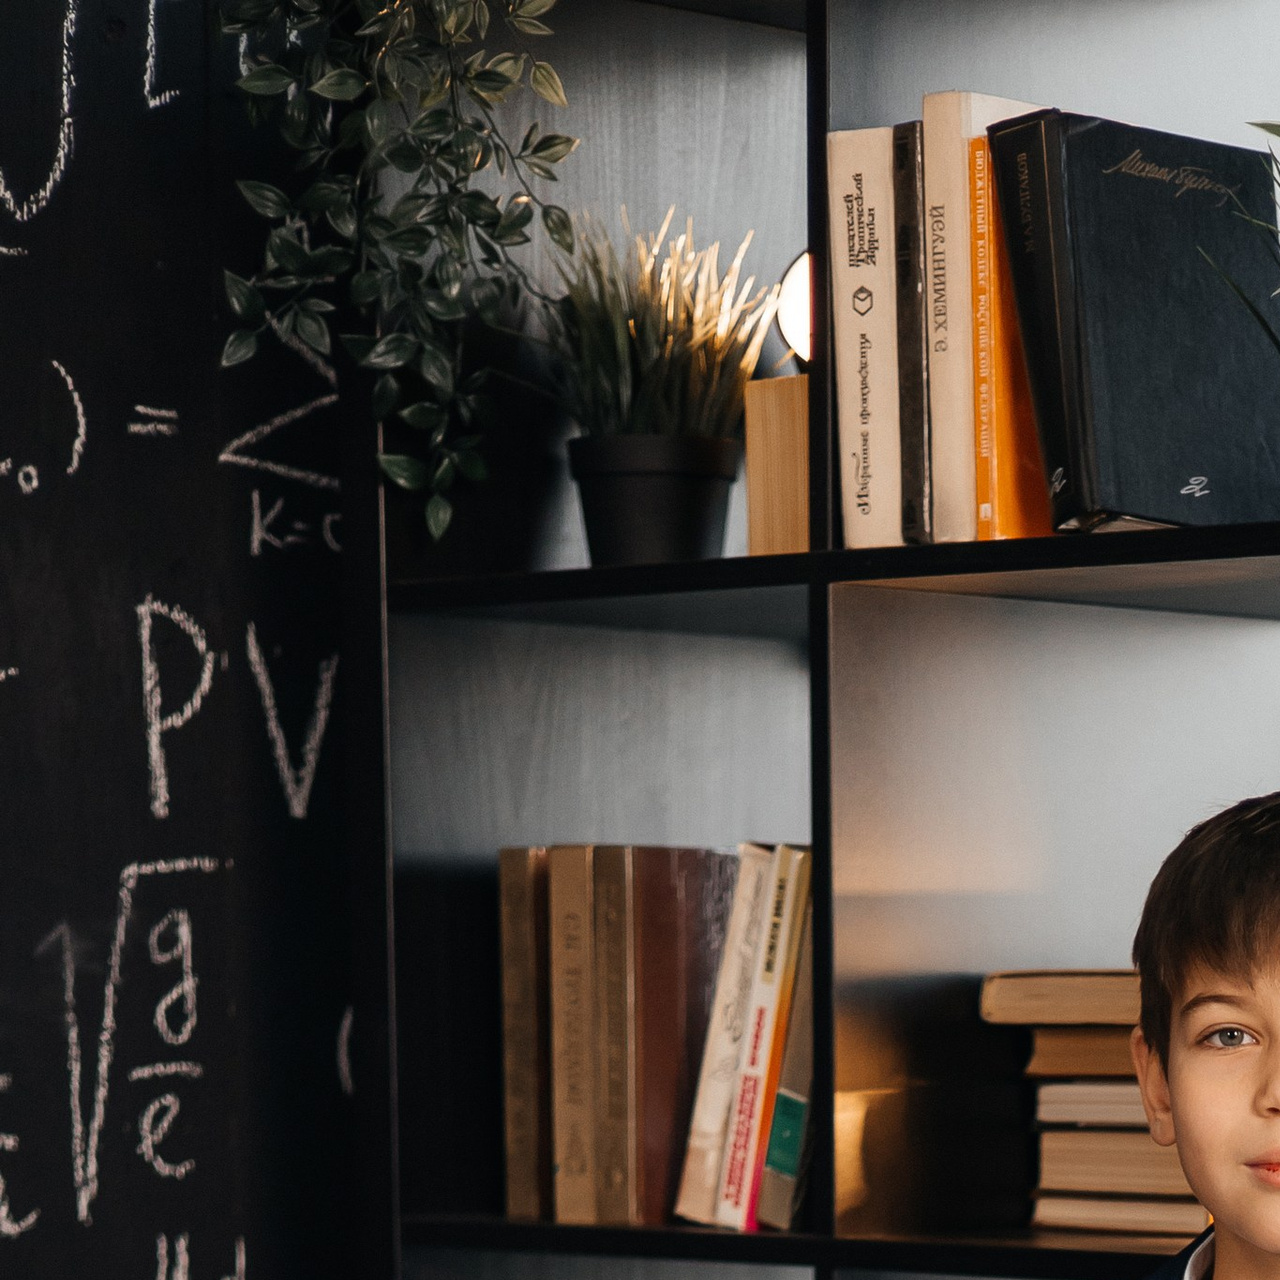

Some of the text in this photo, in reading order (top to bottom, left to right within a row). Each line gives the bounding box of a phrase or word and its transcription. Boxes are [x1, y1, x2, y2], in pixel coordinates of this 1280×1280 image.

[929, 204, 947, 331] ХЕМИНГУЭЙ
[974, 150, 990, 457] БЮДЖЕТНЫЙ КОДЕКС РОССИЙСКОЙ ФЕДЕРАЦИИ
